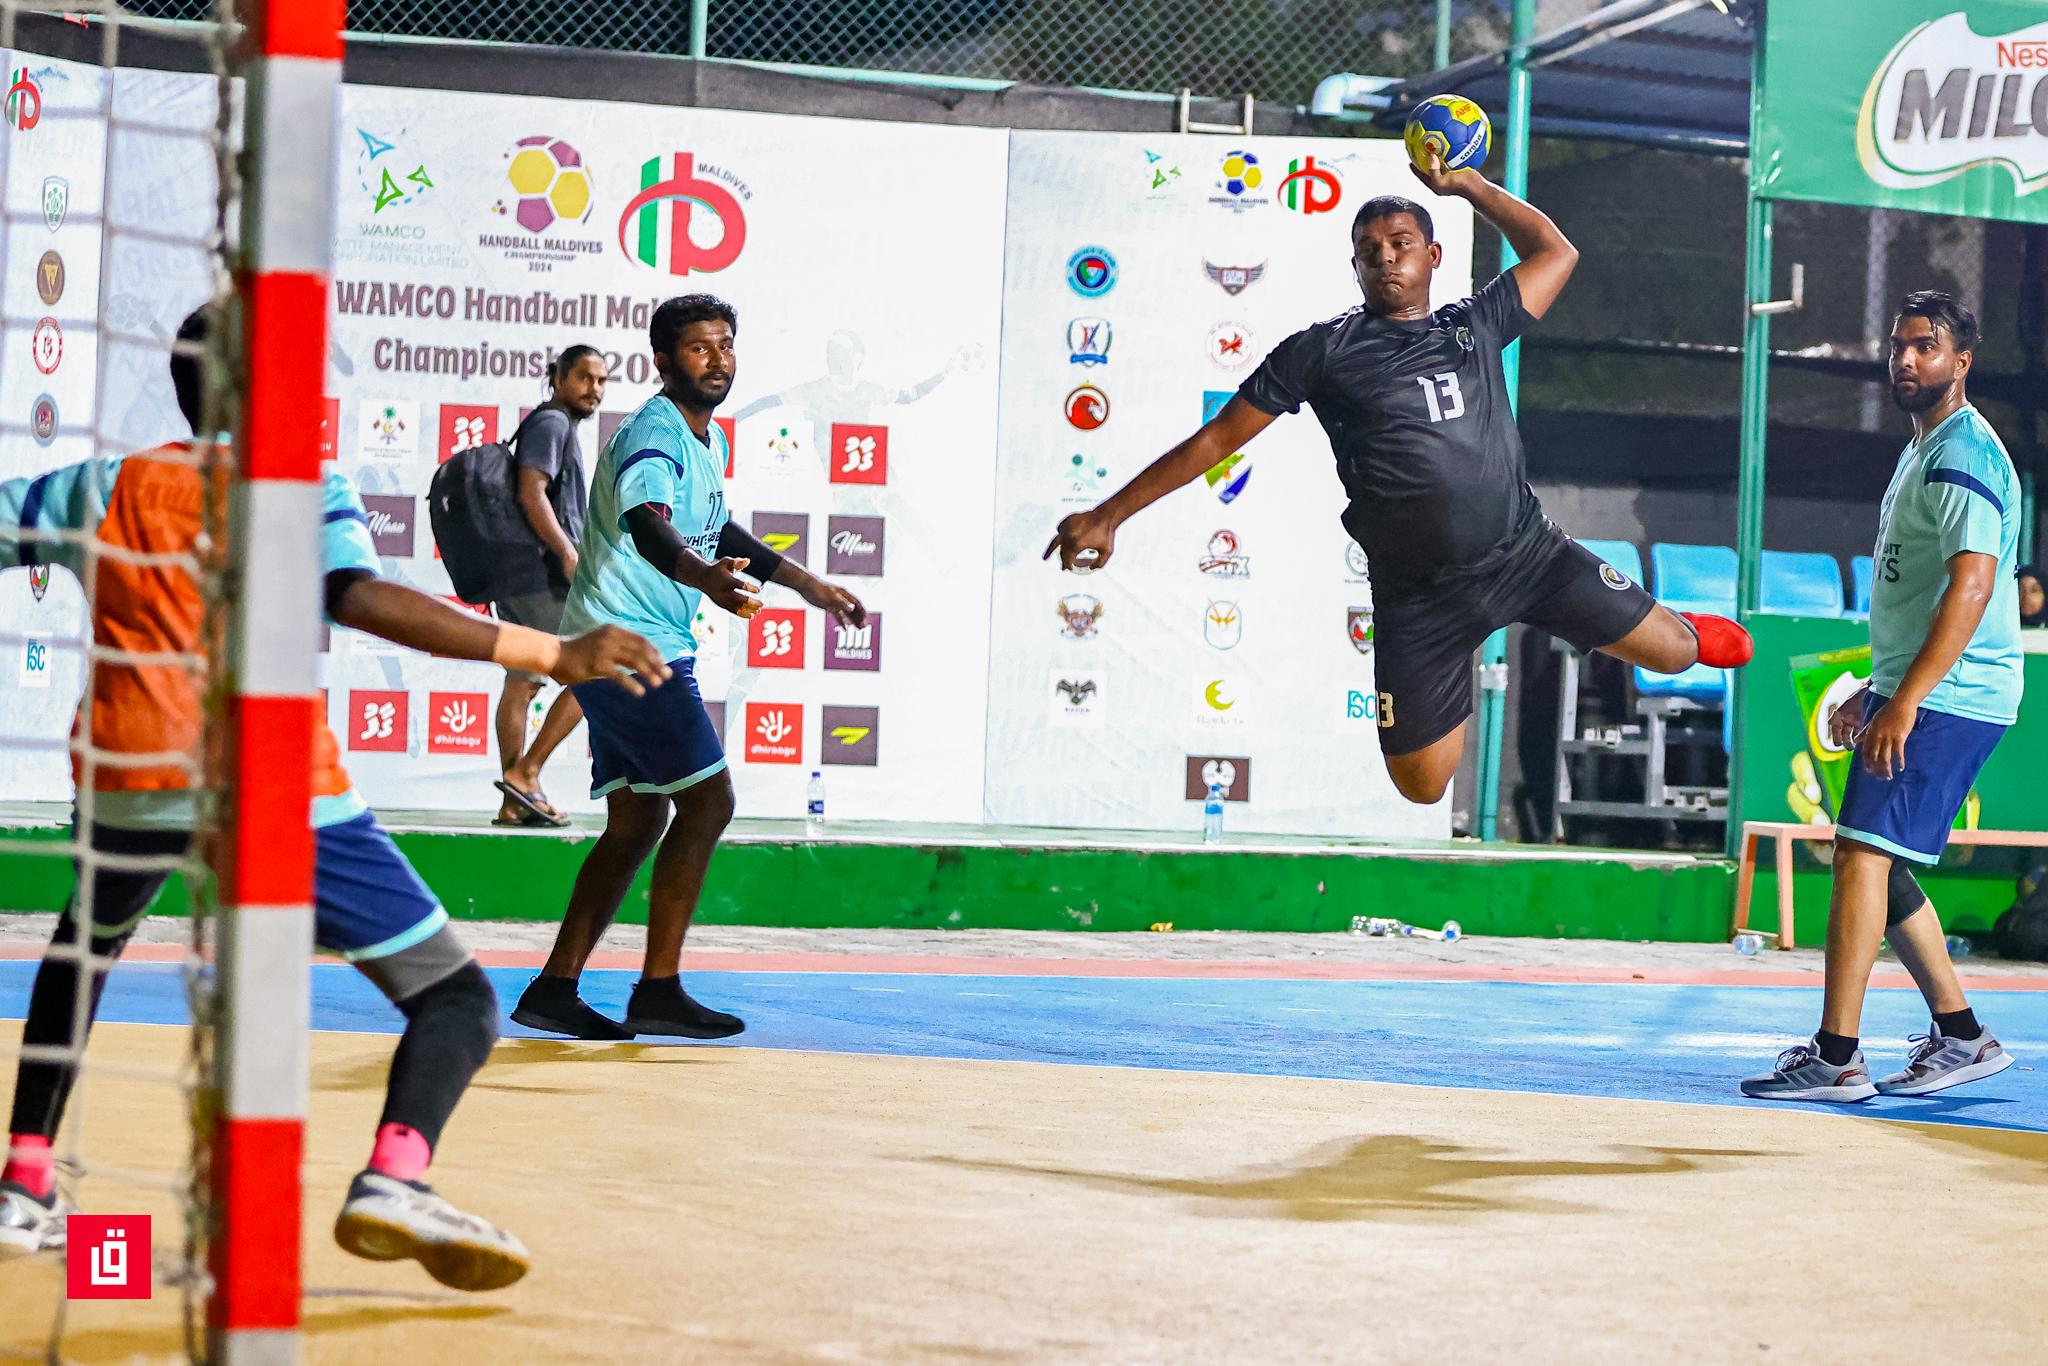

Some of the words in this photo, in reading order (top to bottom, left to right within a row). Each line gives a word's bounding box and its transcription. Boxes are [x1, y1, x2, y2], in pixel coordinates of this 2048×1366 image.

[698, 163, 753, 200] MALDIVES
[360, 223, 426, 239] WAMCO
[479, 234, 541, 250] HANDBALL
[544, 238, 603, 254] MALDIVES
[336, 279, 456, 319] WAMCO
[464, 286, 598, 327] Handball
[1417, 371, 1465, 423] 13
[704, 490, 723, 531] 27
